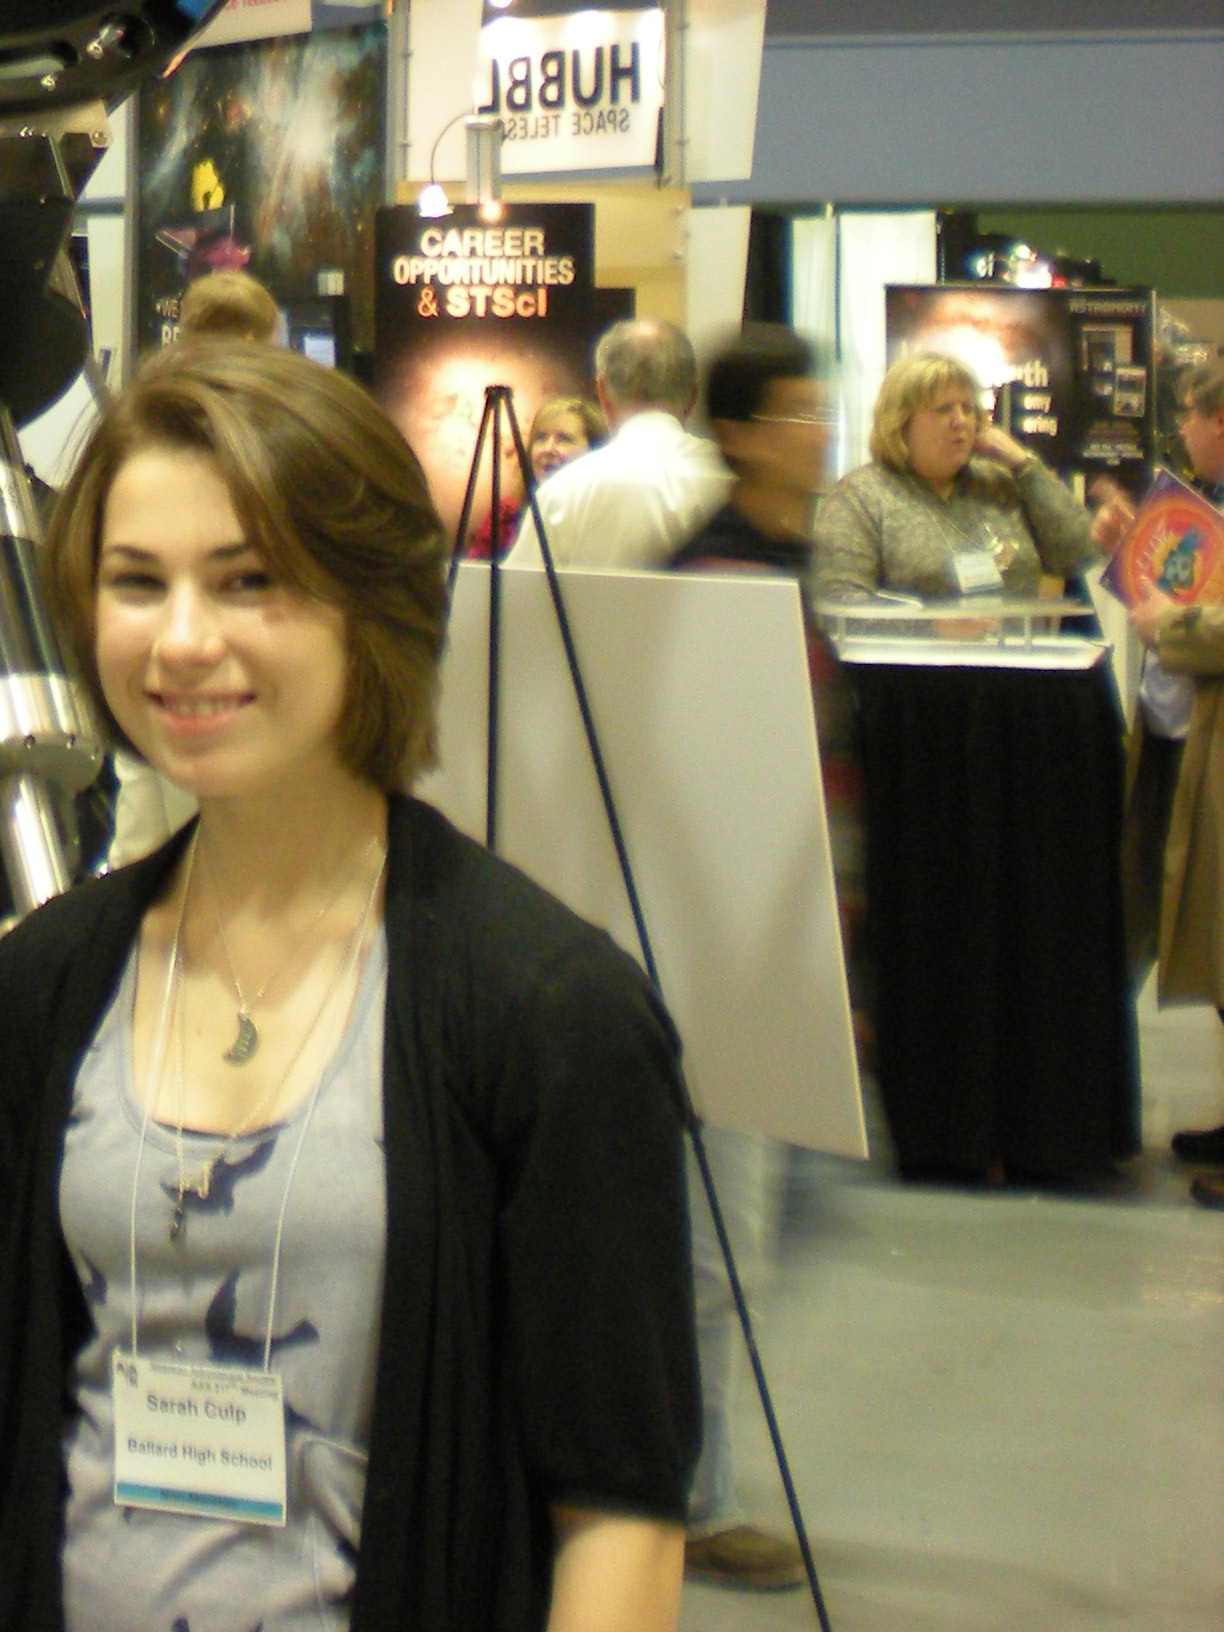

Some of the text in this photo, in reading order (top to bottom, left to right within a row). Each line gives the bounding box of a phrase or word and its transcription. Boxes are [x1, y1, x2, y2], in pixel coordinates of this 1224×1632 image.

[421, 228, 545, 257] CAREER
[394, 255, 575, 286] OPPORTUNITIES
[418, 286, 438, 317] &
[147, 1394, 247, 1424] Sarah Culp
[127, 1436, 272, 1470] Ballard High School
